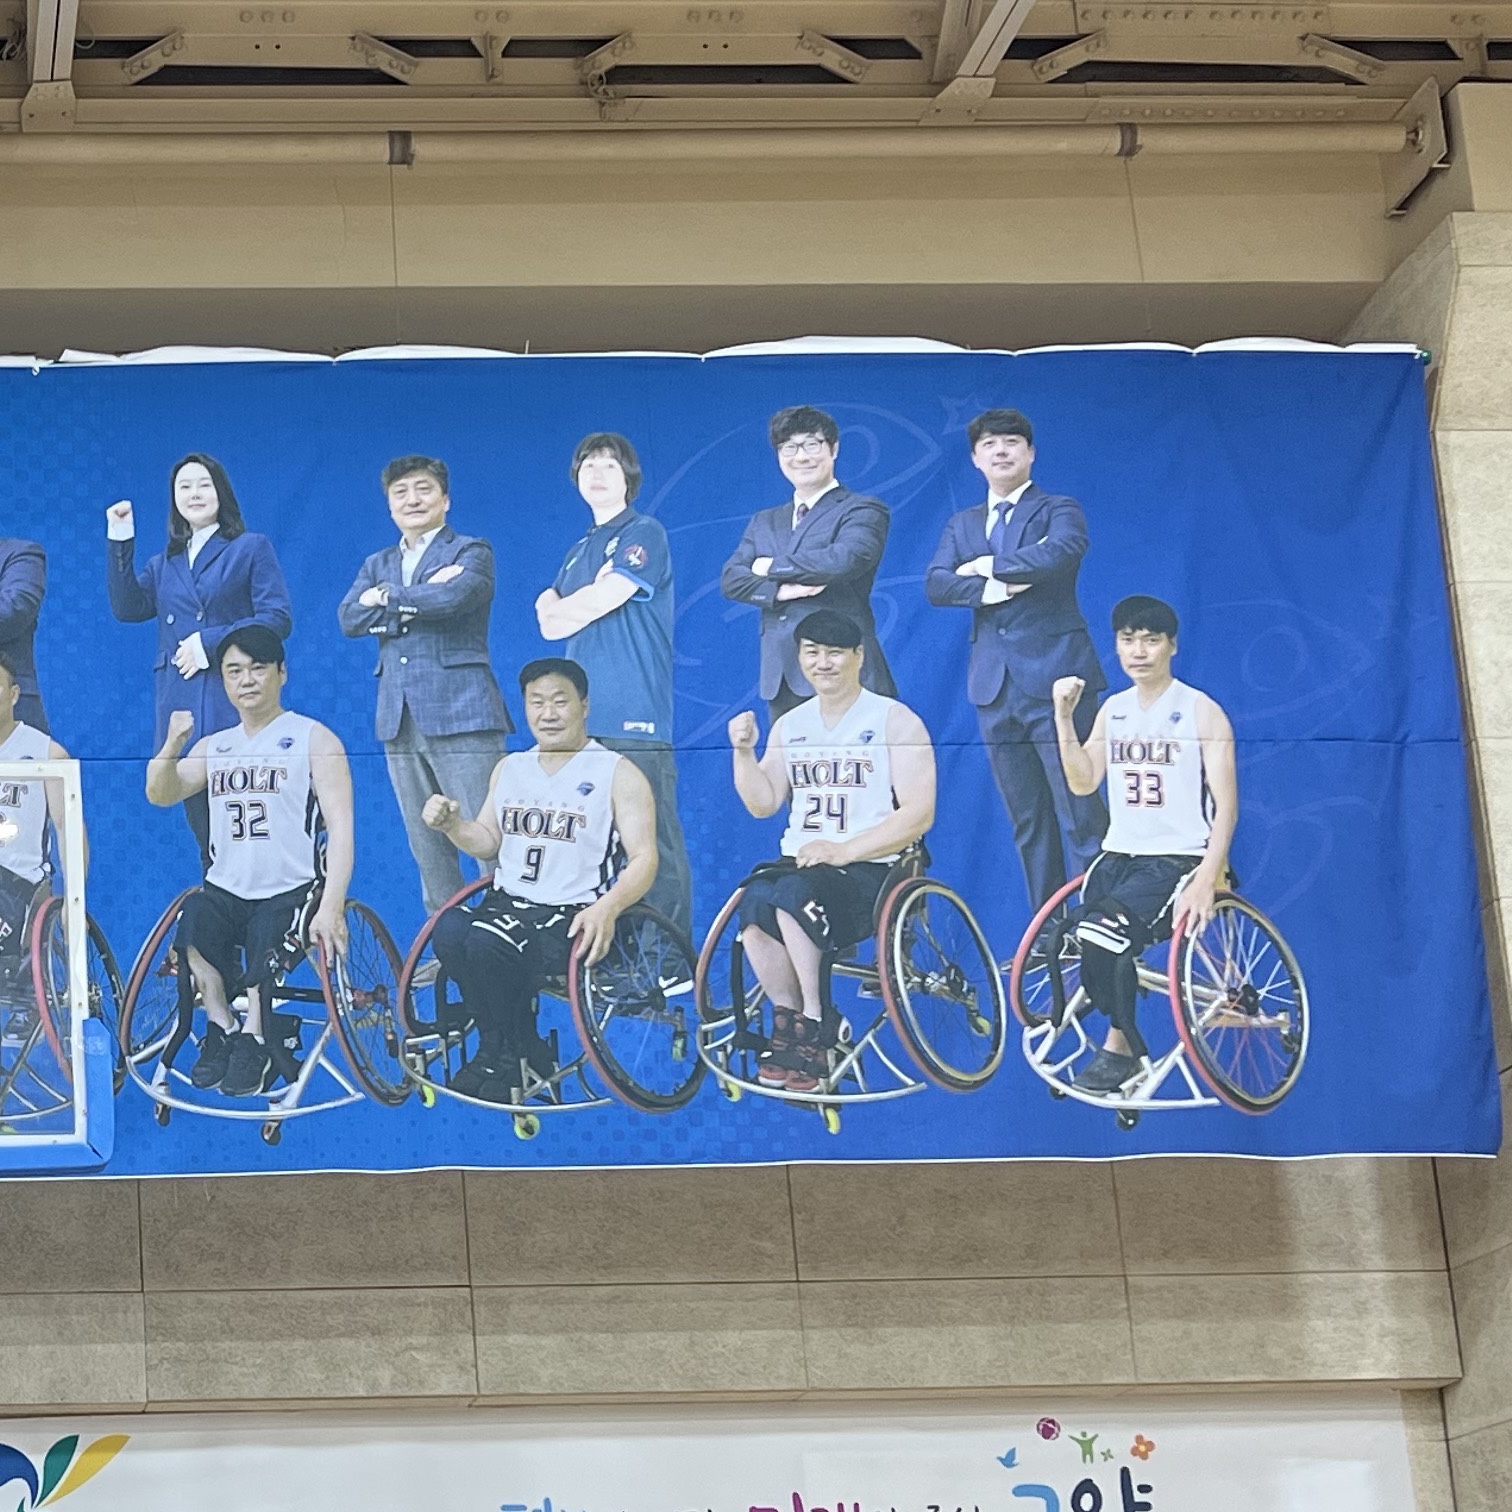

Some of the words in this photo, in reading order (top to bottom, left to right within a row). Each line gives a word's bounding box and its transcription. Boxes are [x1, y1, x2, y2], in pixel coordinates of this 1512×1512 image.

[1110, 740, 1181, 767] HOLT
[211, 765, 288, 798] HOLT
[789, 758, 874, 788] HOLT
[1123, 769, 1165, 808] 33
[225, 800, 270, 841] 32
[501, 806, 586, 843] HOLT
[801, 793, 848, 834] 24
[518, 845, 546, 885] 9
